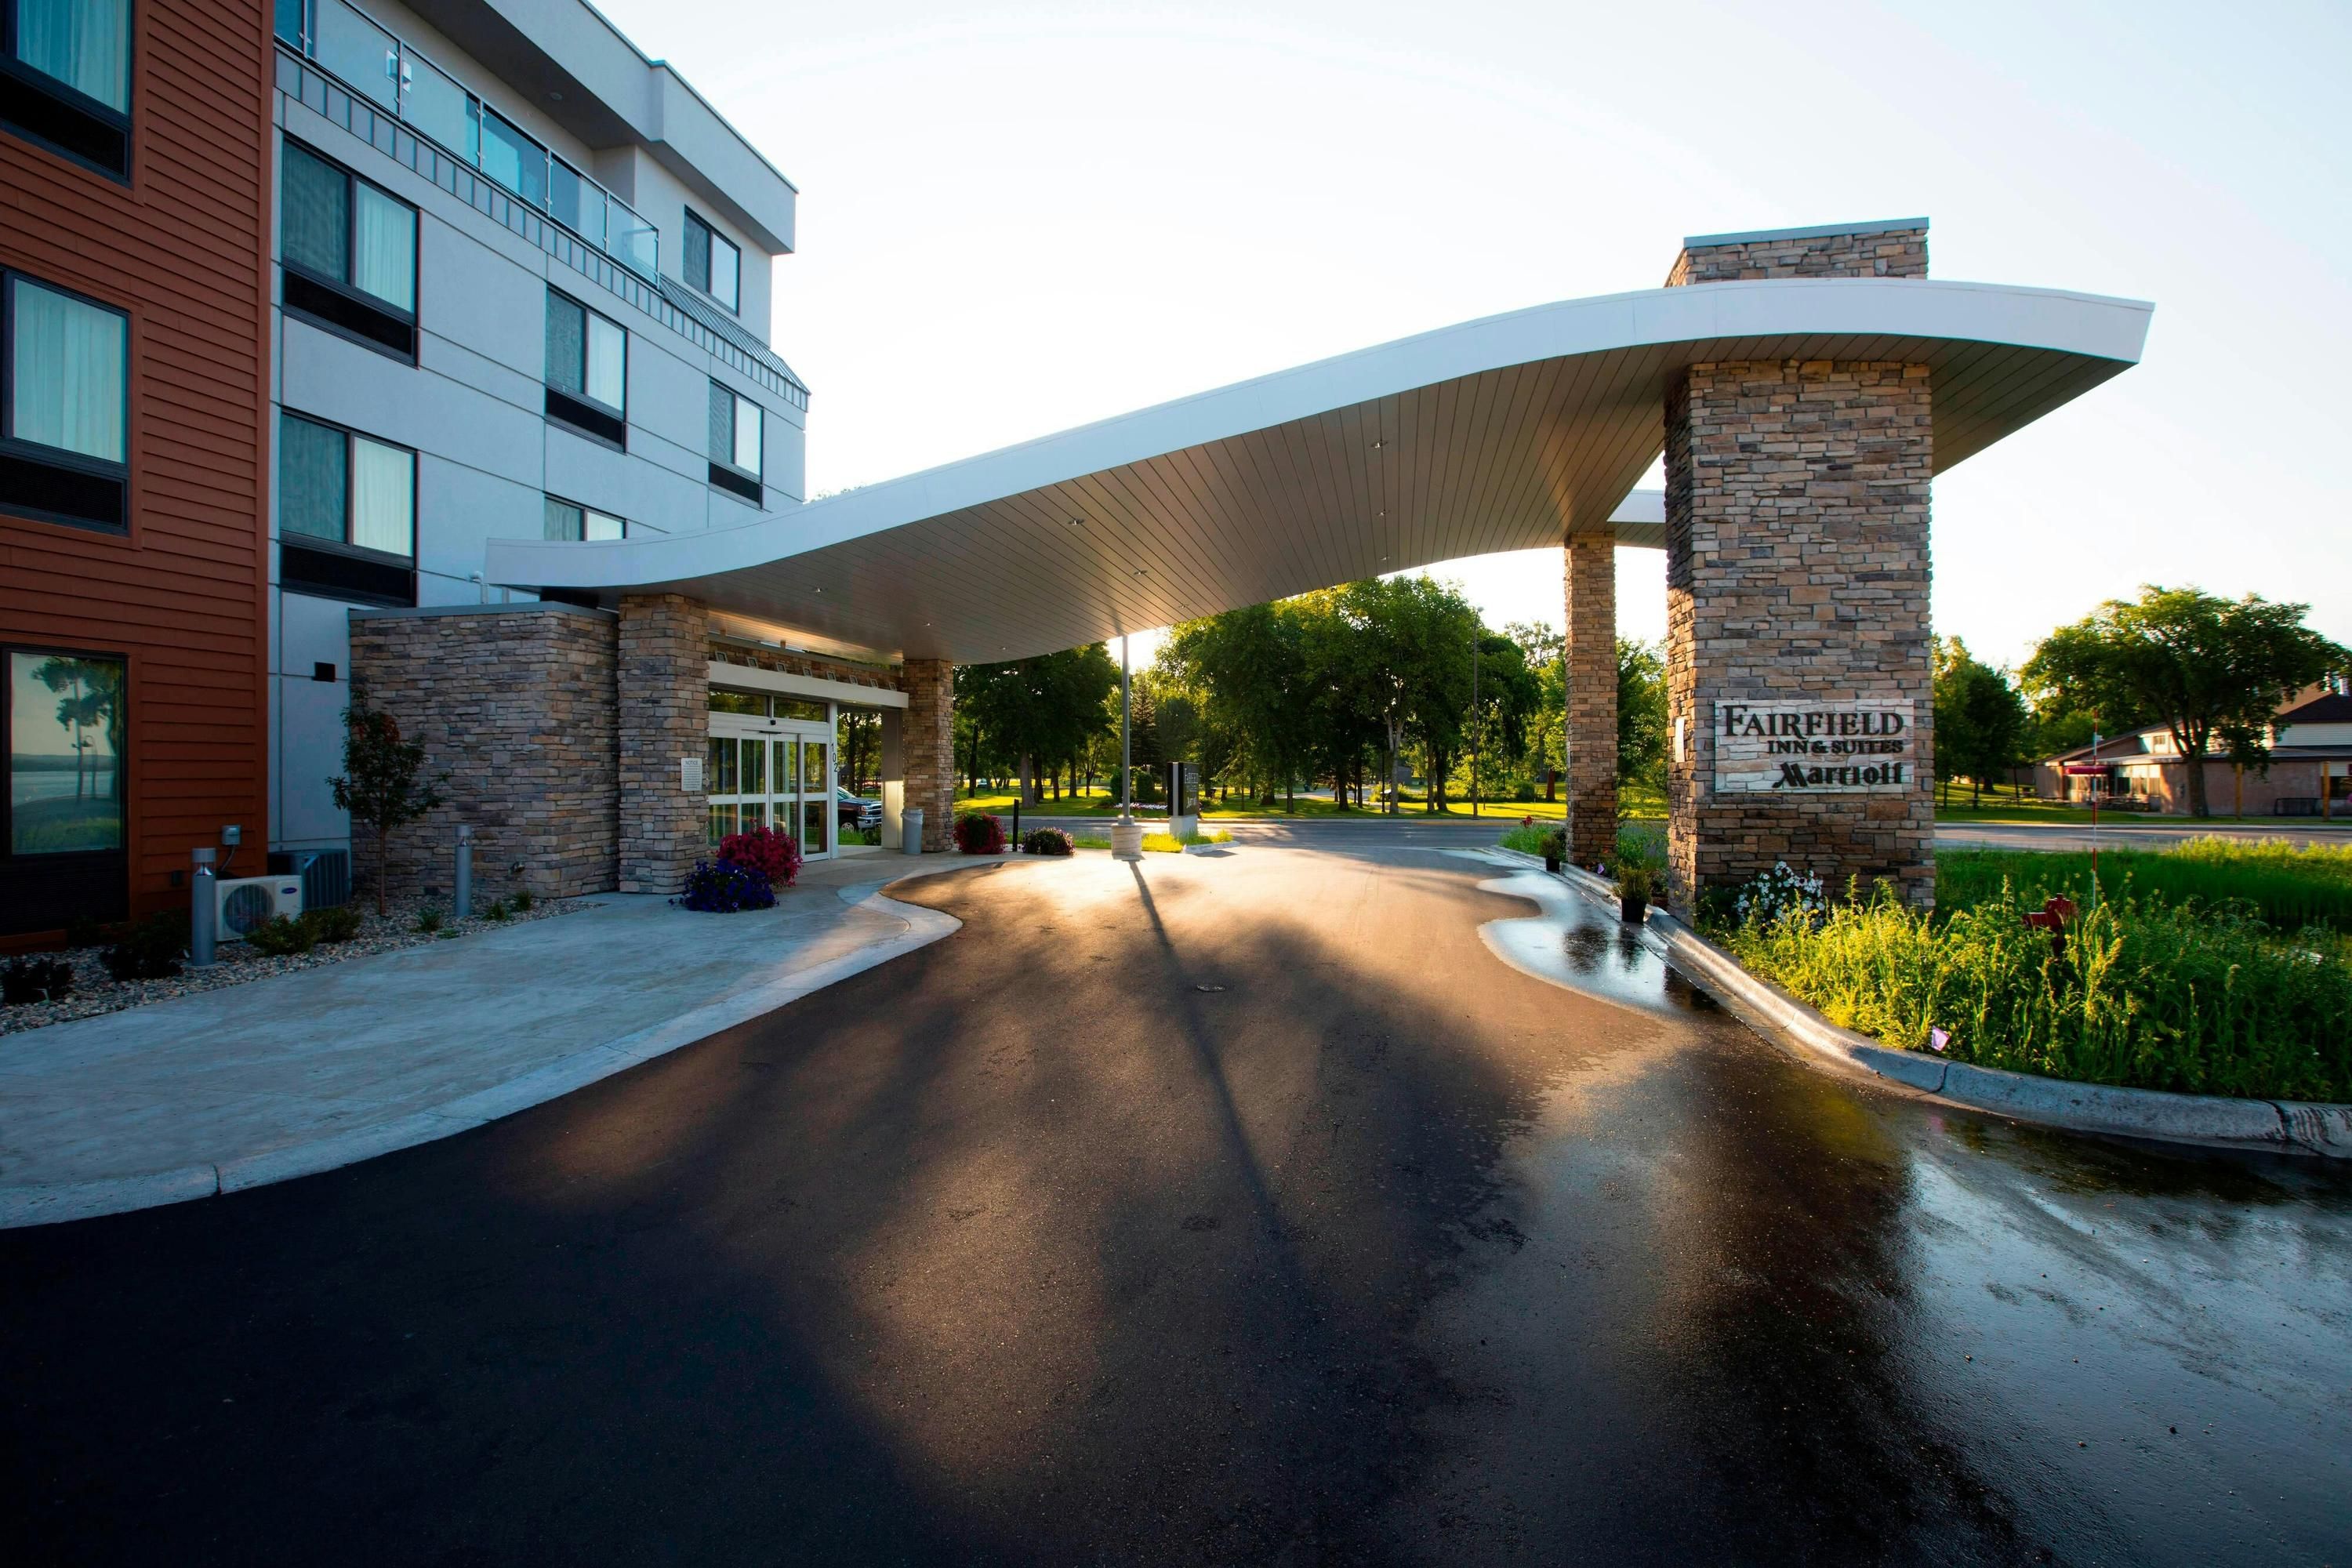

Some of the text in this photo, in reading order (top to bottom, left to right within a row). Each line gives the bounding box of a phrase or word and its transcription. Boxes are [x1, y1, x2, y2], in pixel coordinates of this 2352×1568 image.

[1723, 705, 1904, 739] FAIRFIELD
[1767, 740, 1904, 753] INN & SUITES
[1772, 760, 1904, 789] Marriott
